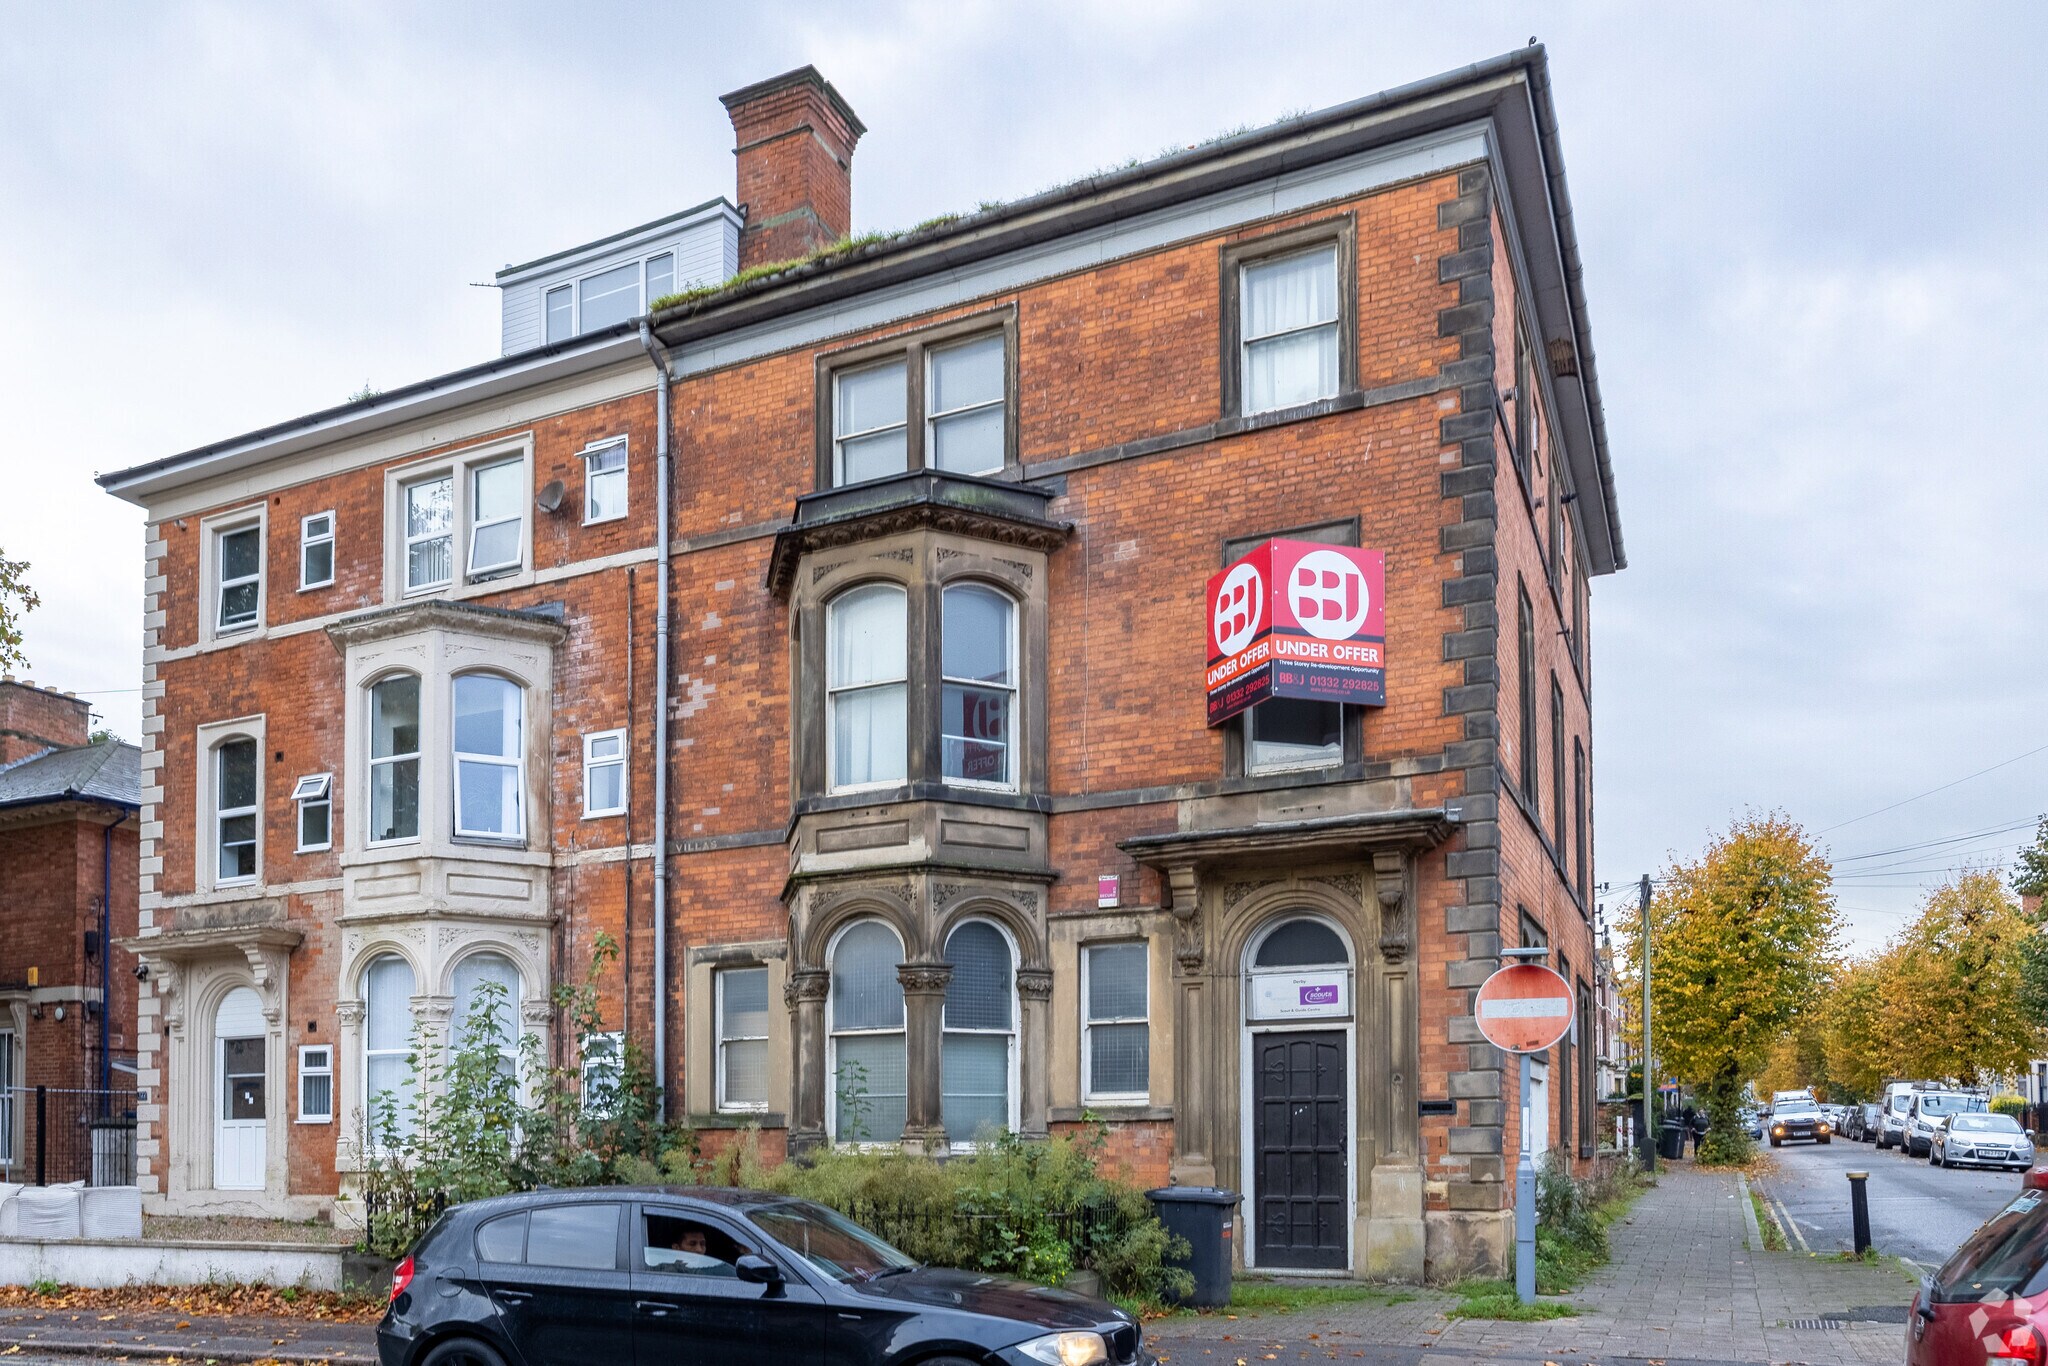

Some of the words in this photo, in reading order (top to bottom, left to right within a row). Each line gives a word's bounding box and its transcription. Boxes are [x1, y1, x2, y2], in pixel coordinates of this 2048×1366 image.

[1275, 640, 1328, 658] UNDER
[1332, 645, 1379, 663] OFFER
[1208, 659, 1237, 685] UNDER
[1240, 642, 1270, 668] OFFER
[1310, 663, 1350, 671] Re-development
[1350, 666, 1380, 675] Opportunity
[1225, 687, 1245, 705] 01332
[1245, 674, 1270, 695] 292825
[1310, 675, 1340, 689] 01332
[1342, 678, 1380, 692] 292825
[675, 840, 718, 852] VILLAS
